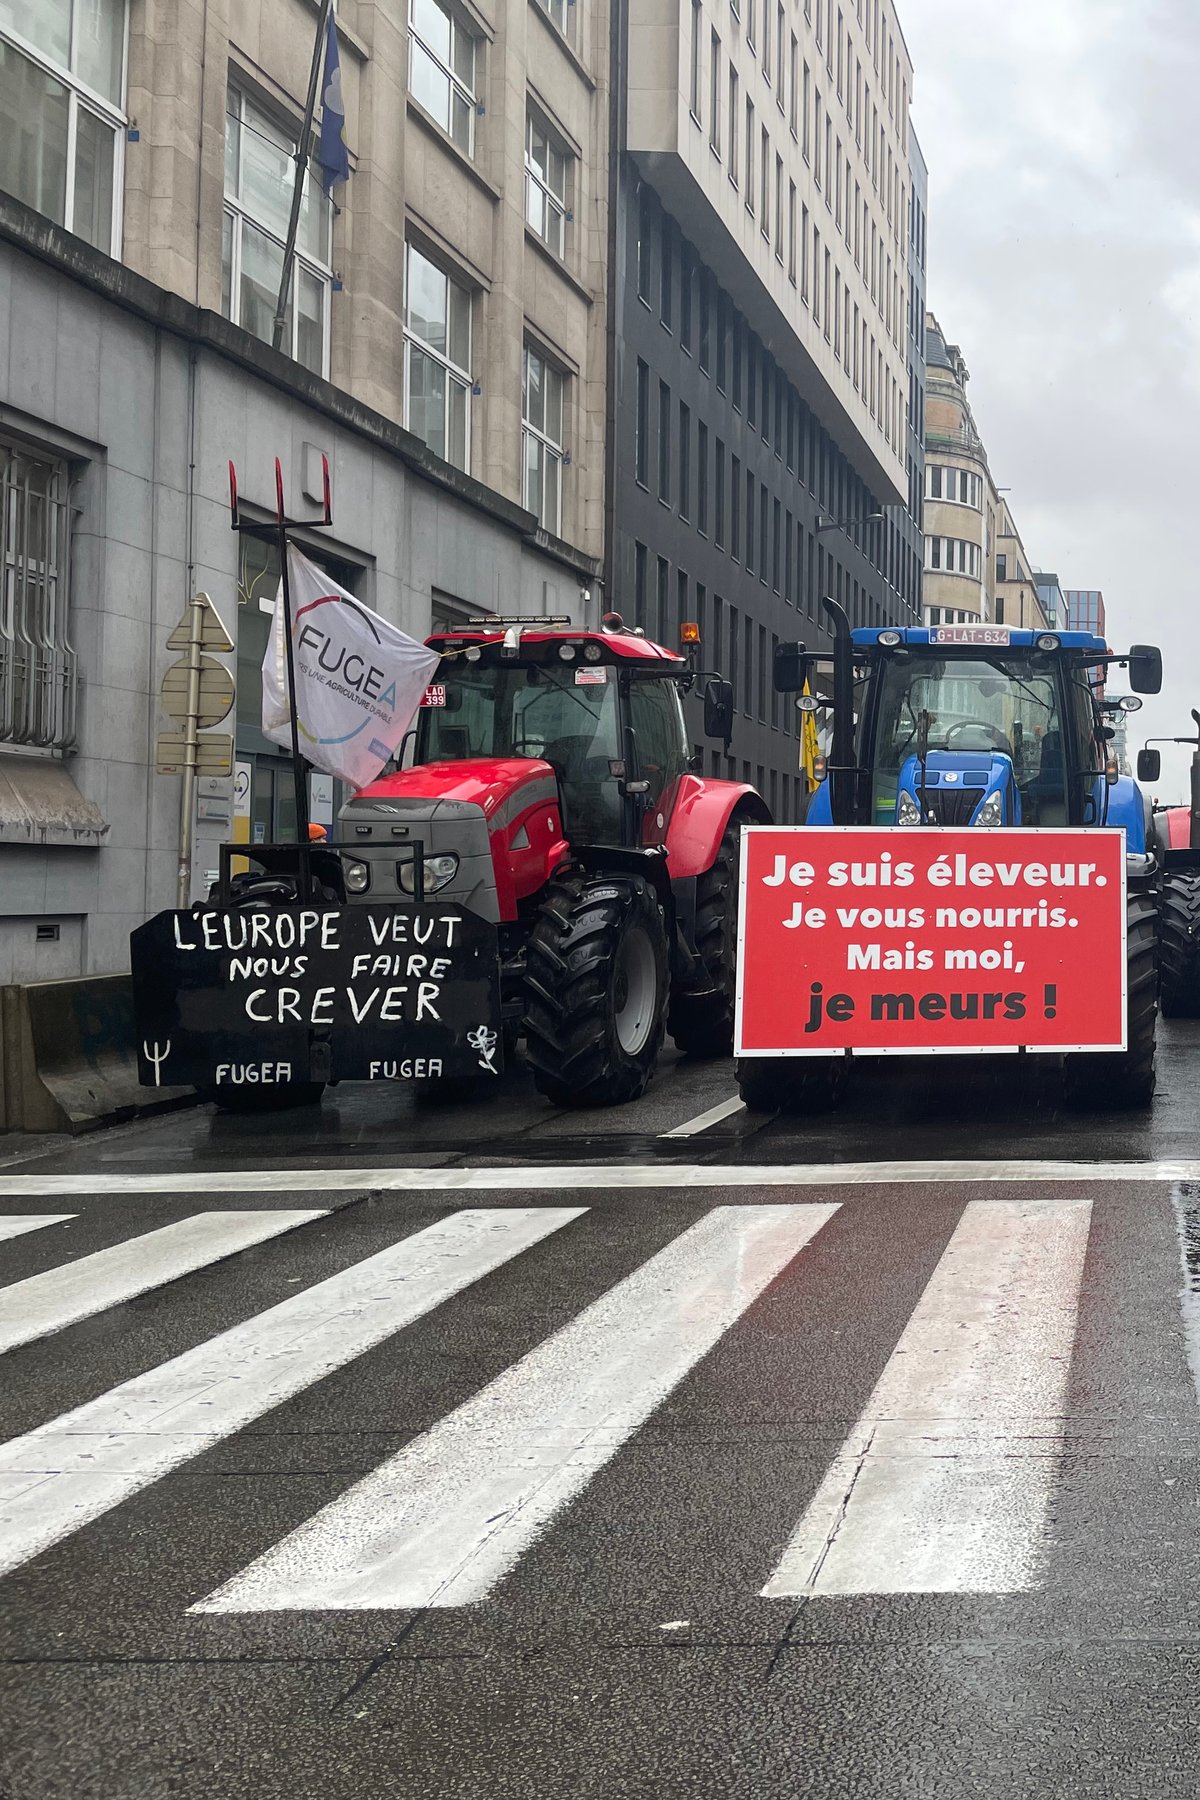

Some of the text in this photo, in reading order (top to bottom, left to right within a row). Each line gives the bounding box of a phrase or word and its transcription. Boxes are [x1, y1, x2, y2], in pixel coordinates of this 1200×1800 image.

[937, 629, 1008, 643] G-LAT-634
[299, 624, 397, 713] FUGEA
[308, 666, 326, 686] UNE
[325, 680, 371, 710] AGRICULTURE
[370, 705, 393, 725] DURABLE
[426, 695, 444, 705] 399
[762, 852, 1107, 887] Je suis éleveur.
[174, 911, 462, 950] L'EUROPE VEUT
[782, 899, 1079, 929] Je vous nourris.
[229, 953, 452, 982] NOUS FAIRE
[847, 940, 1026, 974] Mais moi,
[245, 982, 442, 1025] CREVER
[804, 981, 1057, 1033] je meurs !
[216, 1062, 292, 1085] FUGEA
[370, 1058, 443, 1080] FUGEA
